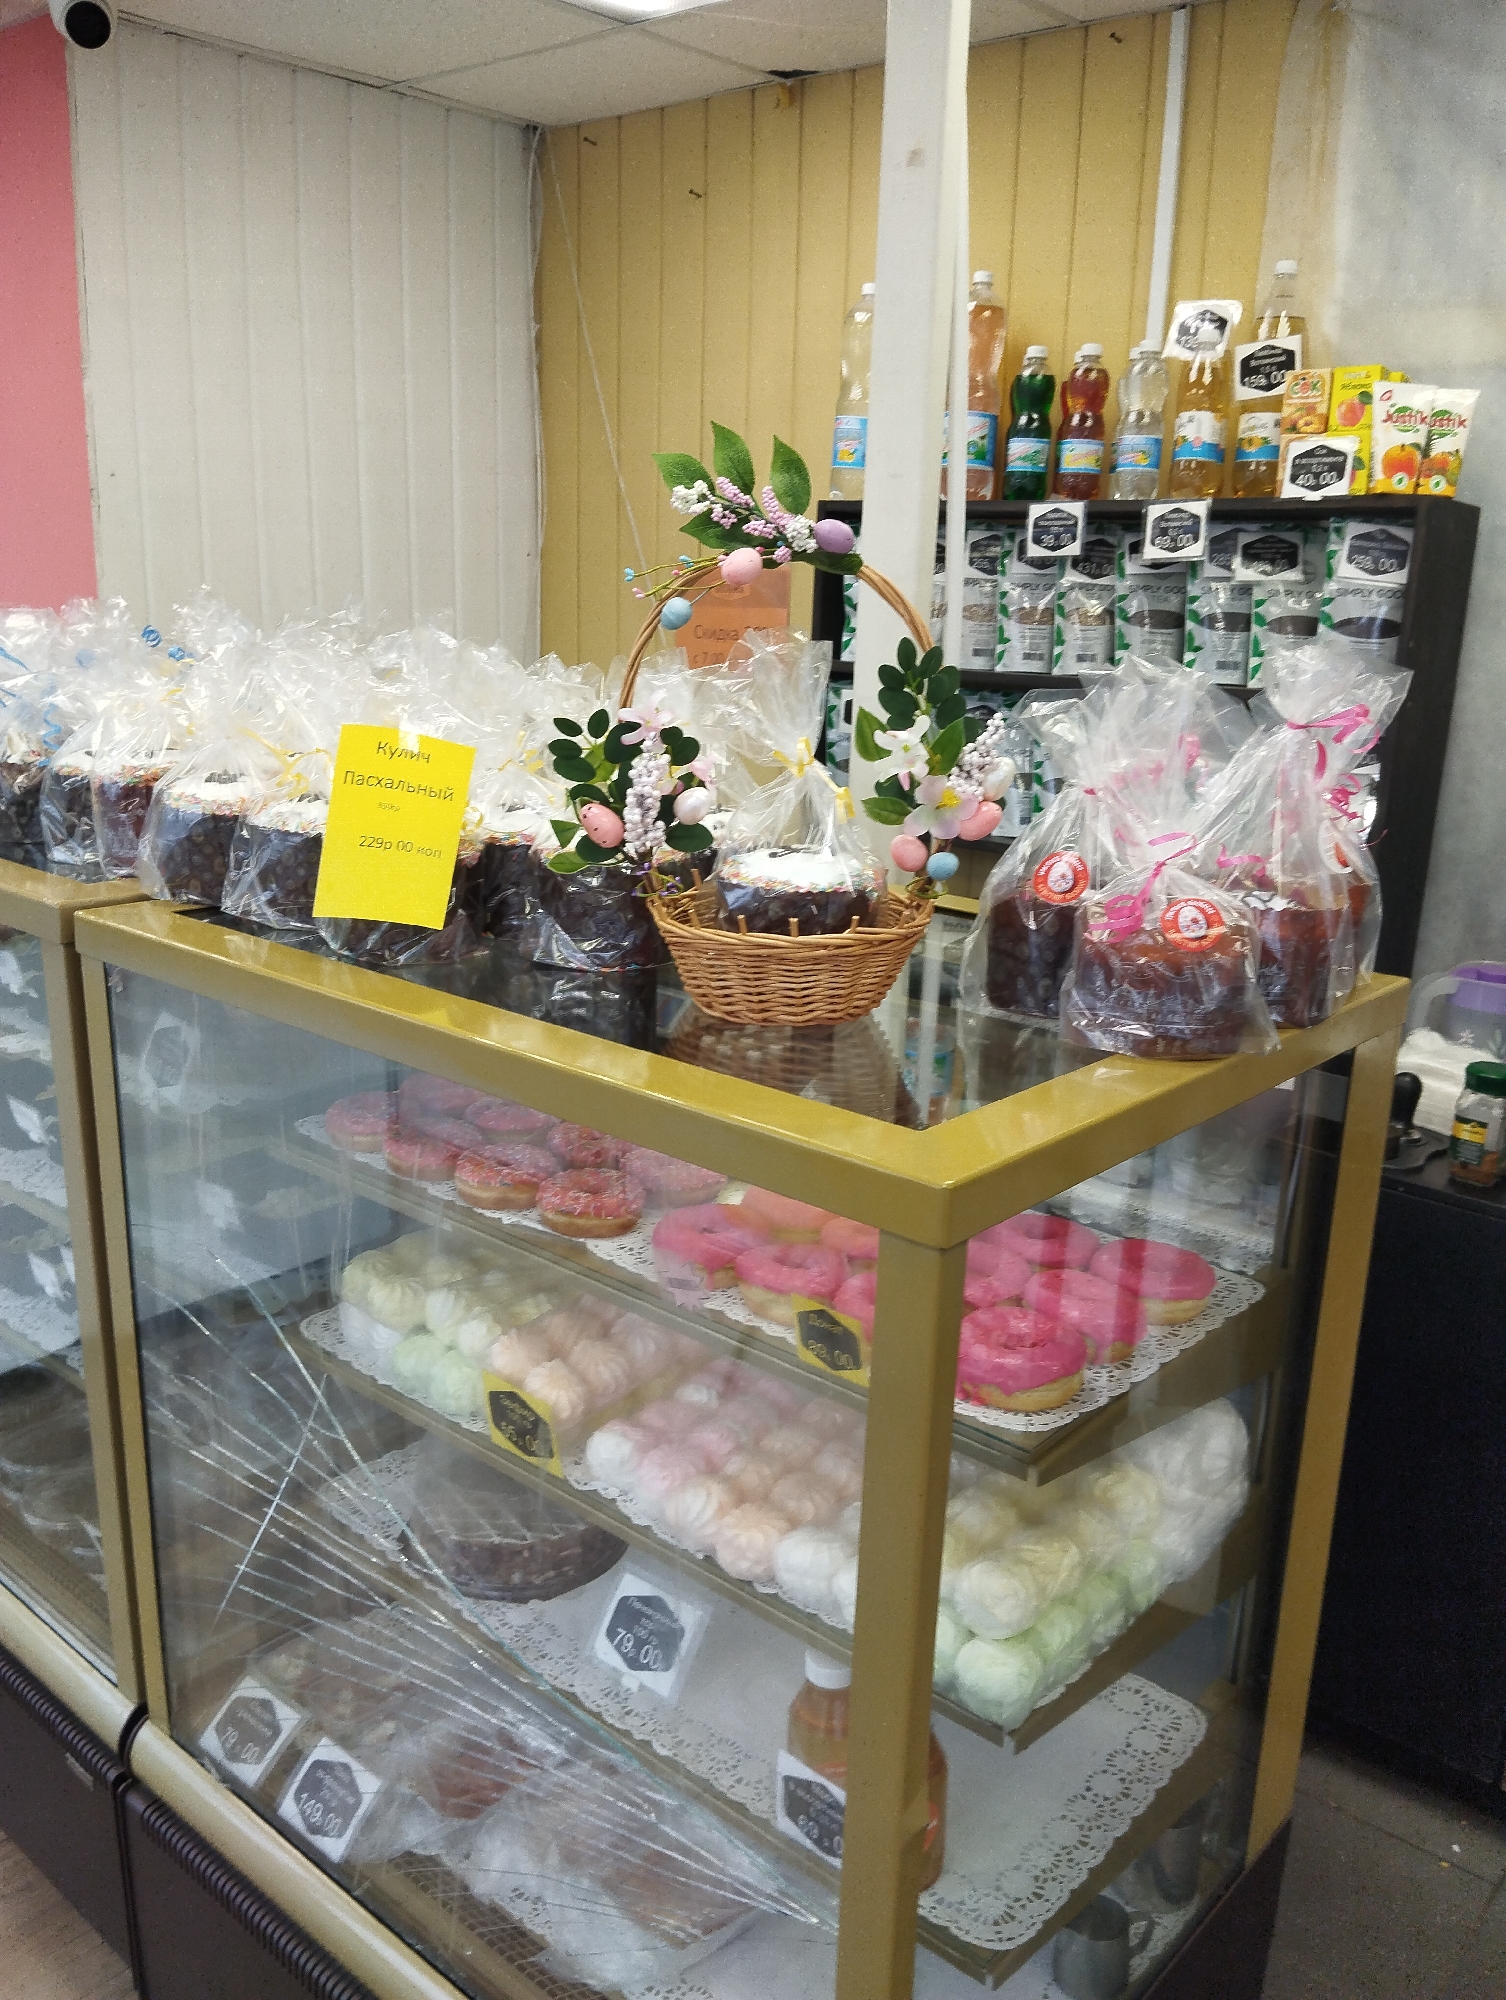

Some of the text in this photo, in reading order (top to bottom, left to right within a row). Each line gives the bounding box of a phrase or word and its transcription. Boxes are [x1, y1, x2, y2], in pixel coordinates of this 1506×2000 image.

[1382, 409, 1429, 425] Justik
[1429, 413, 1468, 429] ustik
[376, 741, 431, 764] Кулич
[343, 770, 454, 801] Пасхальный
[358, 835, 442, 859] 229р 00 коп
